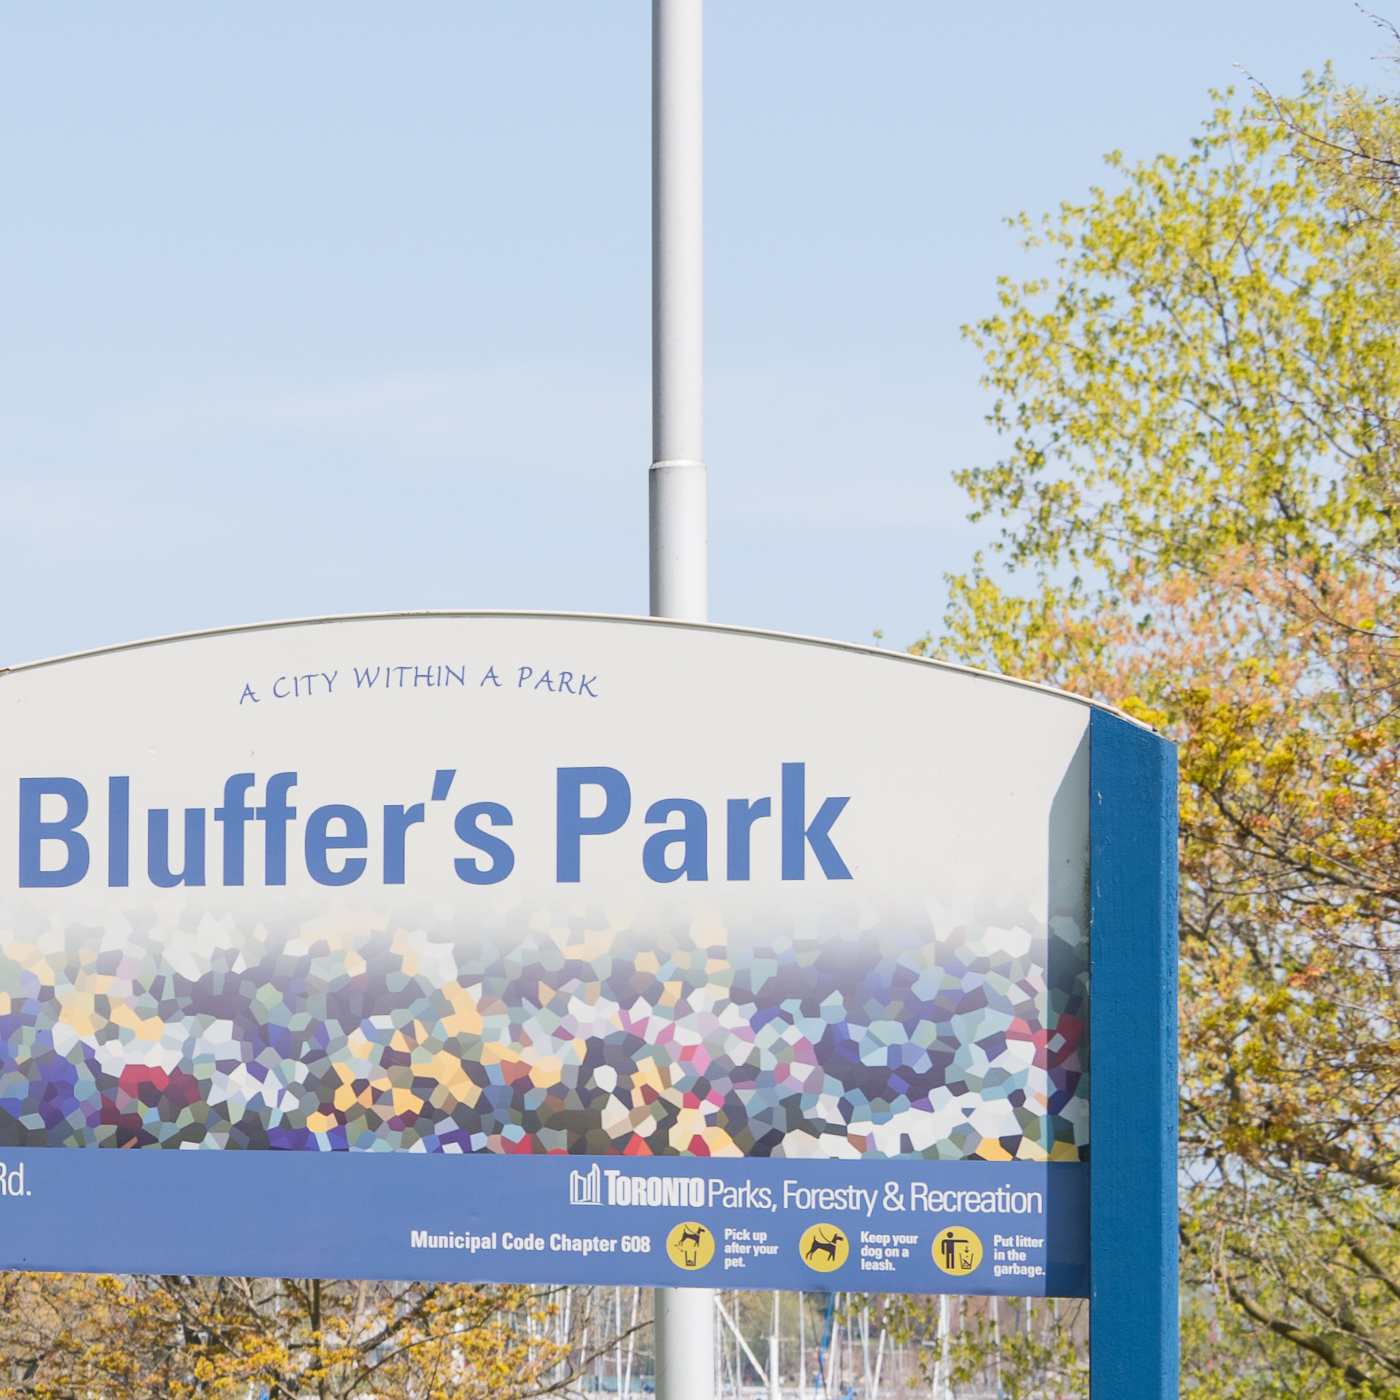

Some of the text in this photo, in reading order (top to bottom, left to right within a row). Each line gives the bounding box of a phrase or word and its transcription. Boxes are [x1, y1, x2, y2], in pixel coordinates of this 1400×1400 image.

[240, 665, 598, 705] A CITY WITHIN A PARK
[18, 761, 854, 889] Bluffer's Park
[604, 1168, 1043, 1217] TORONTO Parks, Forestry & Recreation
[411, 1230, 650, 1256] Municipal Code Chapter 608
[724, 1228, 767, 1245] Pick up
[860, 1231, 919, 1248] Keep your
[993, 1235, 1045, 1249] Put litter
[724, 1242, 779, 1258] after your
[860, 1246, 910, 1261] dog on a
[993, 1248, 1027, 1262] in the
[724, 1256, 746, 1270] pet.
[860, 1258, 896, 1272] leash.
[993, 1262, 1046, 1278] garbage.
